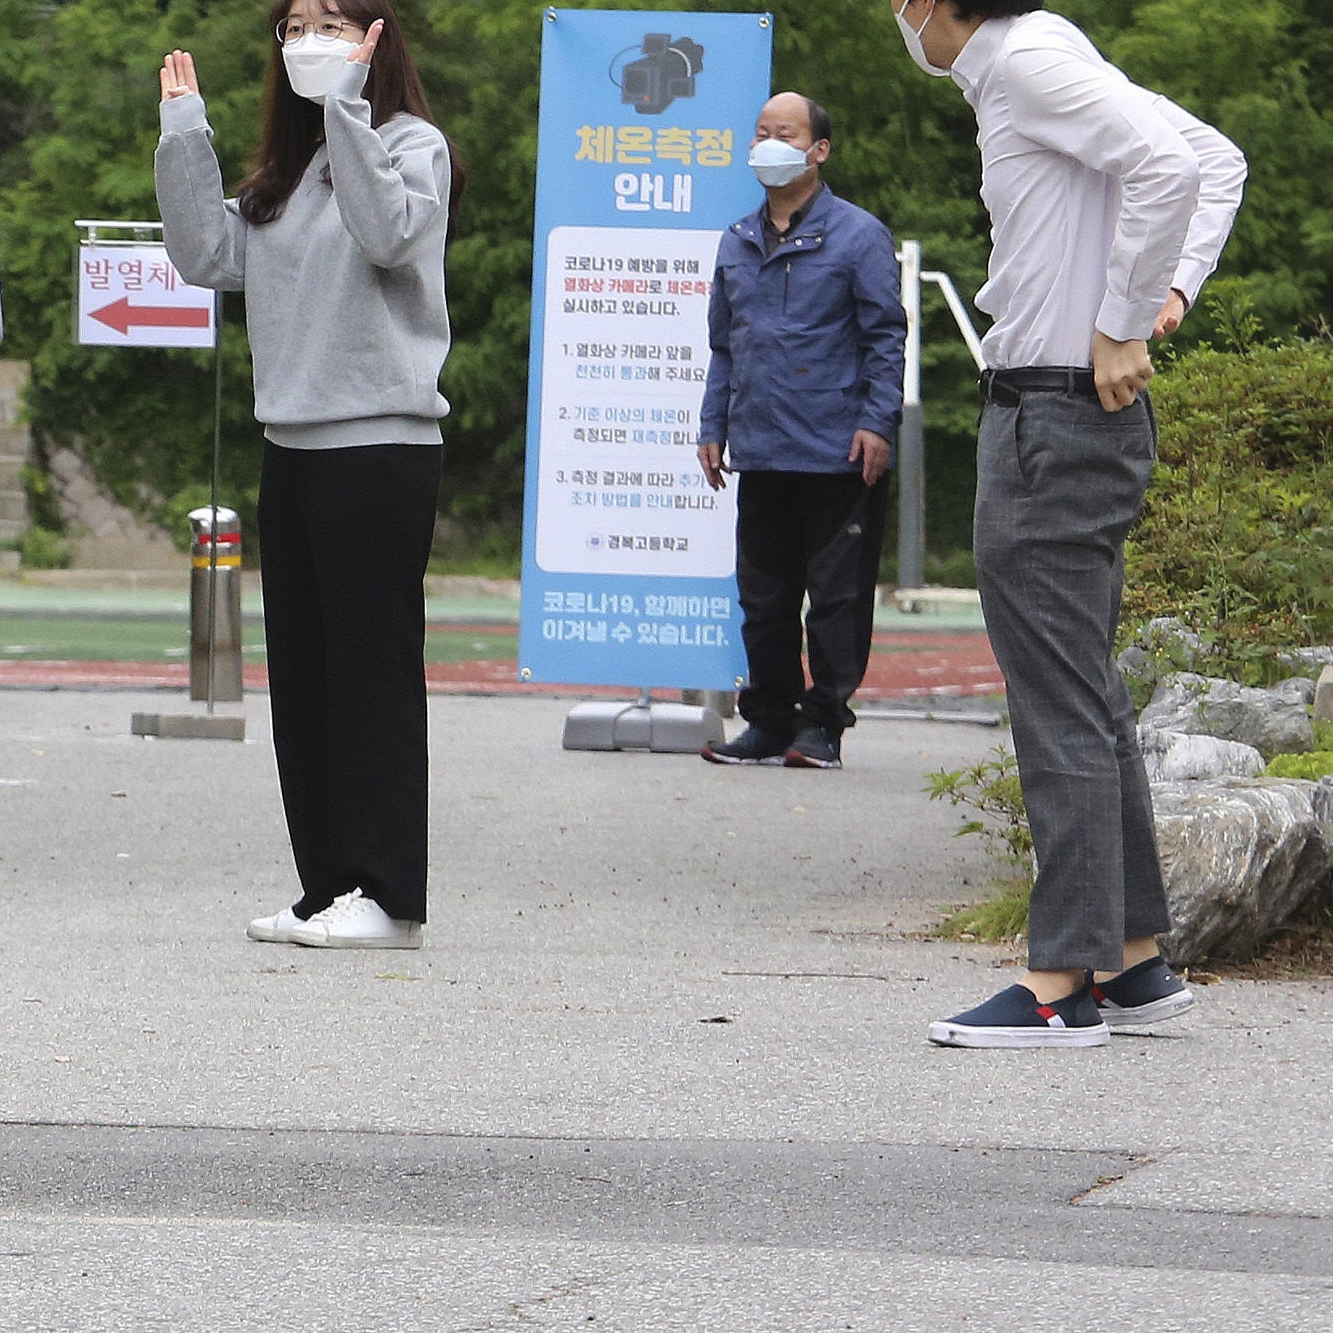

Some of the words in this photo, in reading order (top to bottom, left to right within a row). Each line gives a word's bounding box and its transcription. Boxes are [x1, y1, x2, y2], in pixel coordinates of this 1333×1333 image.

[575, 124, 733, 167] 체온측정
[614, 172, 692, 213] 안내
[565, 256, 623, 272] 코로나19
[628, 258, 668, 274] 예방을
[673, 260, 699, 274] 위해
[84, 259, 185, 292] 발열체
[564, 277, 604, 293] 열화상
[608, 279, 662, 293] 카메라로
[563, 298, 617, 314] 실시하고
[622, 300, 680, 316] 있습니다.
[562, 343, 574, 357] 1.
[576, 342, 616, 358] 열화상
[621, 344, 662, 360] 카메라
[665, 367, 706, 382] 주세요
[558, 407, 571, 420] 2.
[573, 427, 626, 444] 측정되면
[555, 470, 568, 483] 3.
[571, 470, 598, 485] 측정
[647, 472, 674, 487] 따라
[646, 494, 718, 509] 안내합니다.
[543, 591, 639, 616] 코로나19,
[645, 594, 731, 619] 함께하면
[542, 619, 607, 643] 이겨낼
[610, 621, 633, 643] 수
[638, 622, 730, 647] 있습니다.
